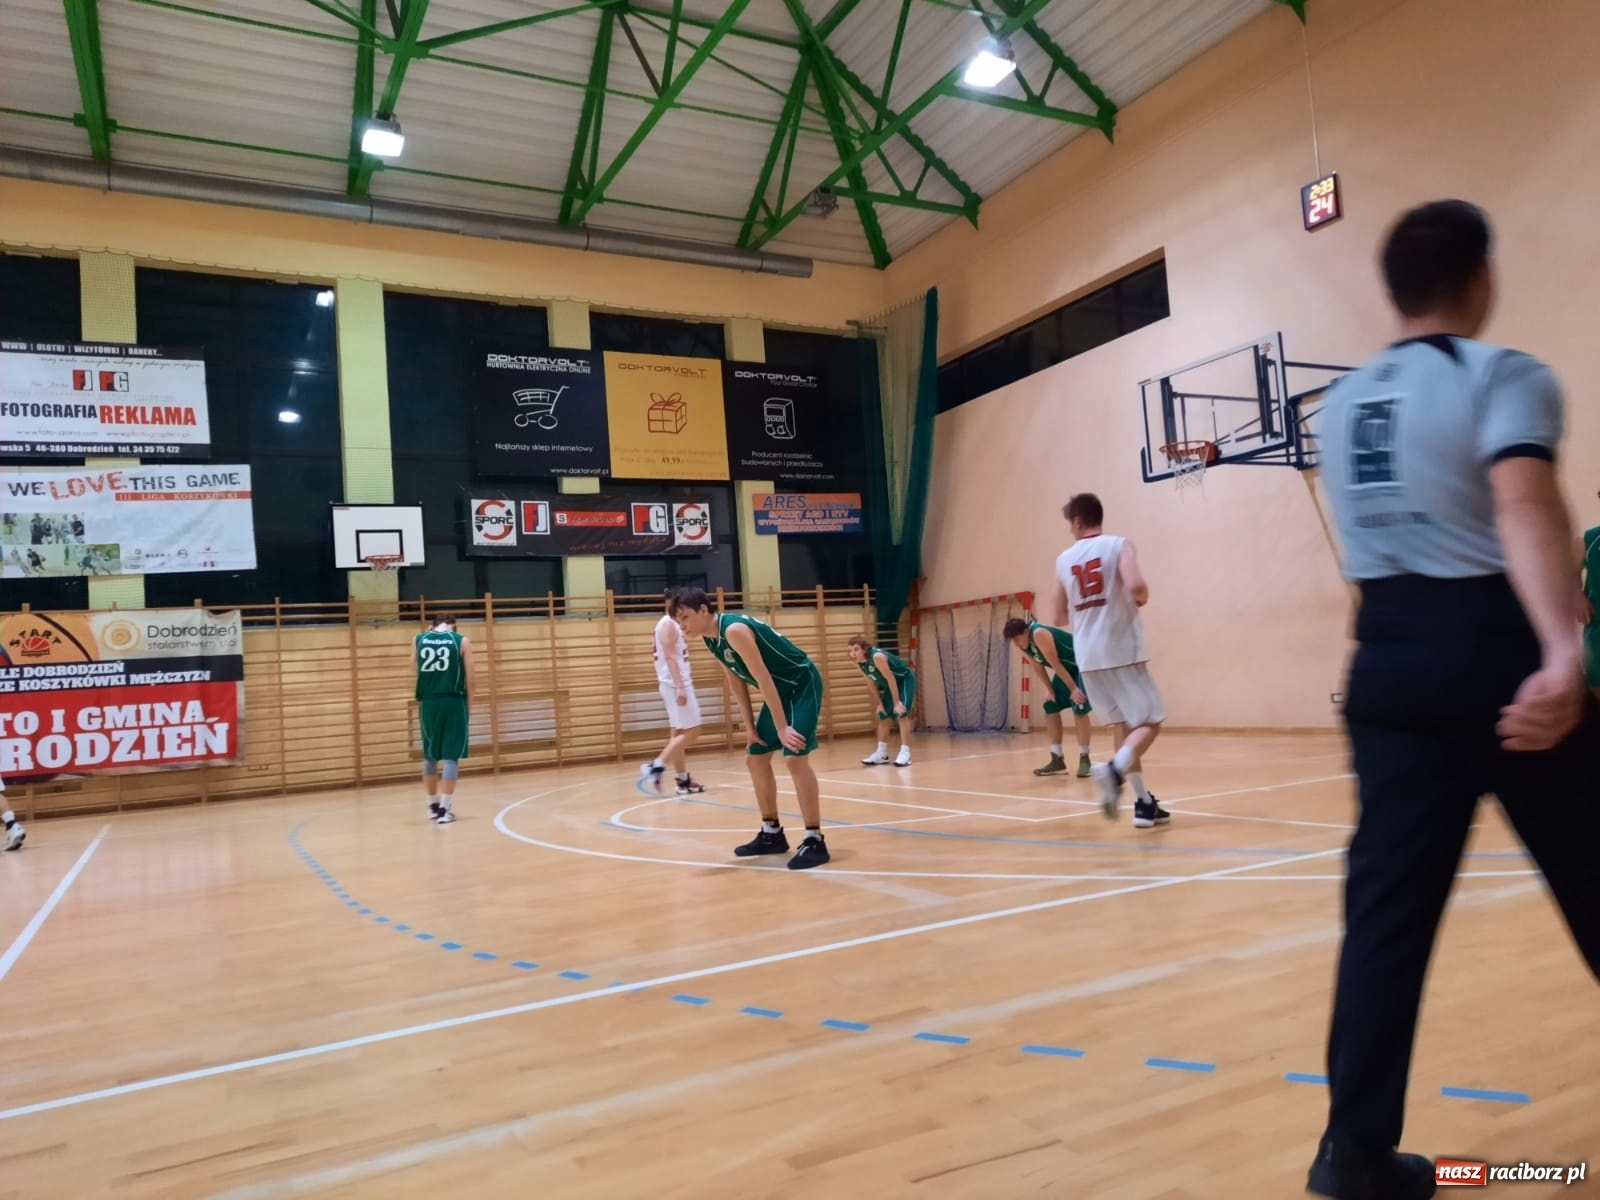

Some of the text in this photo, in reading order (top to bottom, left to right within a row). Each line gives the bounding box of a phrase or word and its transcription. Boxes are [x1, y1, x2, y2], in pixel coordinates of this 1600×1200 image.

[1309, 193, 1333, 223] 24
[1, 341, 27, 351] WWW
[36, 343, 65, 352] ULOTKI
[486, 360, 525, 370] HURTOWNIA
[569, 366, 591, 374] ONLINE
[487, 353, 587, 367] DOKTORVOLT
[618, 362, 708, 375] DOKTORVOLT
[100, 371, 129, 392] PG
[734, 370, 815, 382] DOKTORVOLT
[1, 402, 197, 425] FOTOGRAFIA REKLAMA
[532, 443, 550, 452] sklep
[551, 444, 593, 453] internetowy
[8, 472, 241, 500] WE LOVE THIS GAME
[763, 495, 806, 509] ARES
[634, 505, 666, 533] PG
[1071, 557, 1104, 599] 15
[9, 628, 62, 648] START
[147, 622, 238, 638] Dobrodzień
[420, 646, 450, 672] 23
[23, 661, 125, 679] DOBRODZIEŃ
[19, 673, 126, 692] KOSZYKÓWKI
[130, 670, 211, 687] MĘŻCZYZN
[51, 708, 65, 733] I
[77, 700, 205, 731] GMINA
[0, 717, 229, 772] RODZIEŃ
